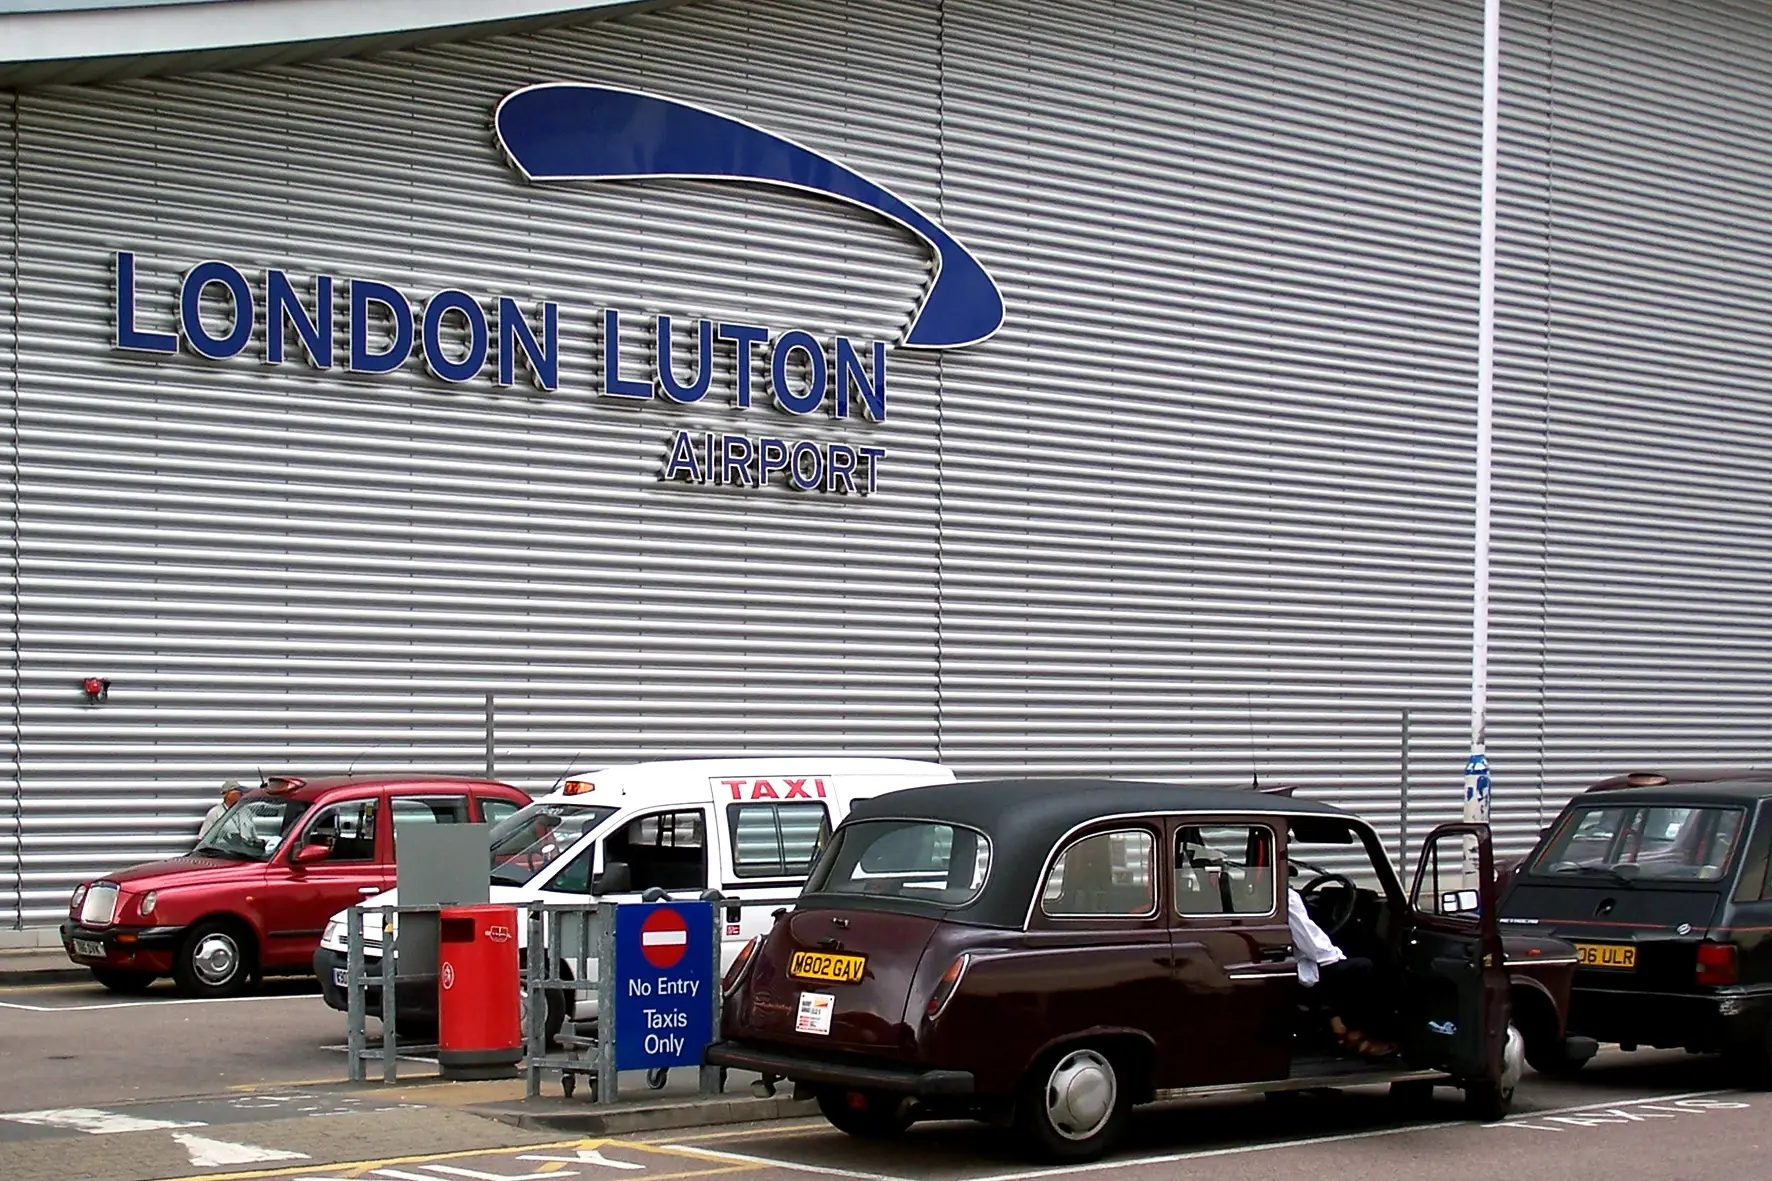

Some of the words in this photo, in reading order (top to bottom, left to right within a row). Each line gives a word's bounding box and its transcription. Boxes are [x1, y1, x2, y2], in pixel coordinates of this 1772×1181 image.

[116, 250, 559, 390] LONDON
[603, 307, 886, 422] LUTON
[665, 428, 886, 492] AIRPORT
[721, 778, 827, 800] TAXI
[793, 955, 832, 976] M802
[833, 959, 863, 980] GAV
[1602, 949, 1634, 965] ULR
[628, 978, 652, 997] No
[658, 977, 700, 997] Entry
[643, 1008, 688, 1029] Taxis
[644, 1033, 685, 1057] Only
[1479, 1099, 1751, 1132] TAXIS
